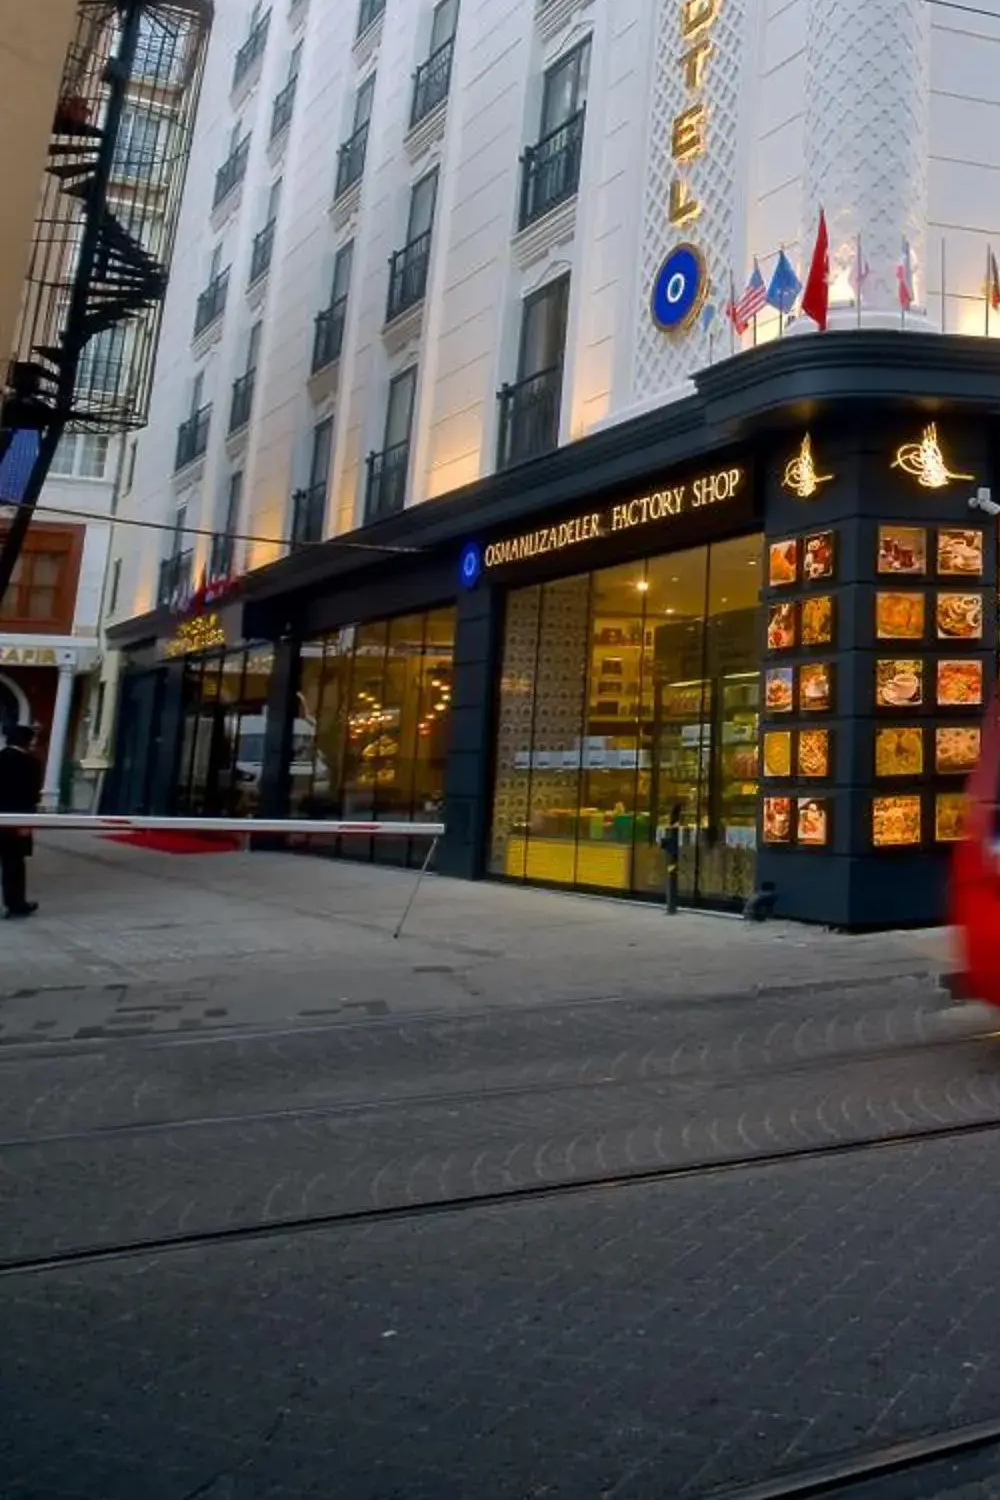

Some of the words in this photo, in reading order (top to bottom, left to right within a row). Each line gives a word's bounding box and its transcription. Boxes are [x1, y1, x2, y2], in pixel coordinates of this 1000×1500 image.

[485, 513, 600, 567] OSMANLIZADELER
[611, 486, 685, 531] FACTORY
[692, 468, 740, 507] SHOP
